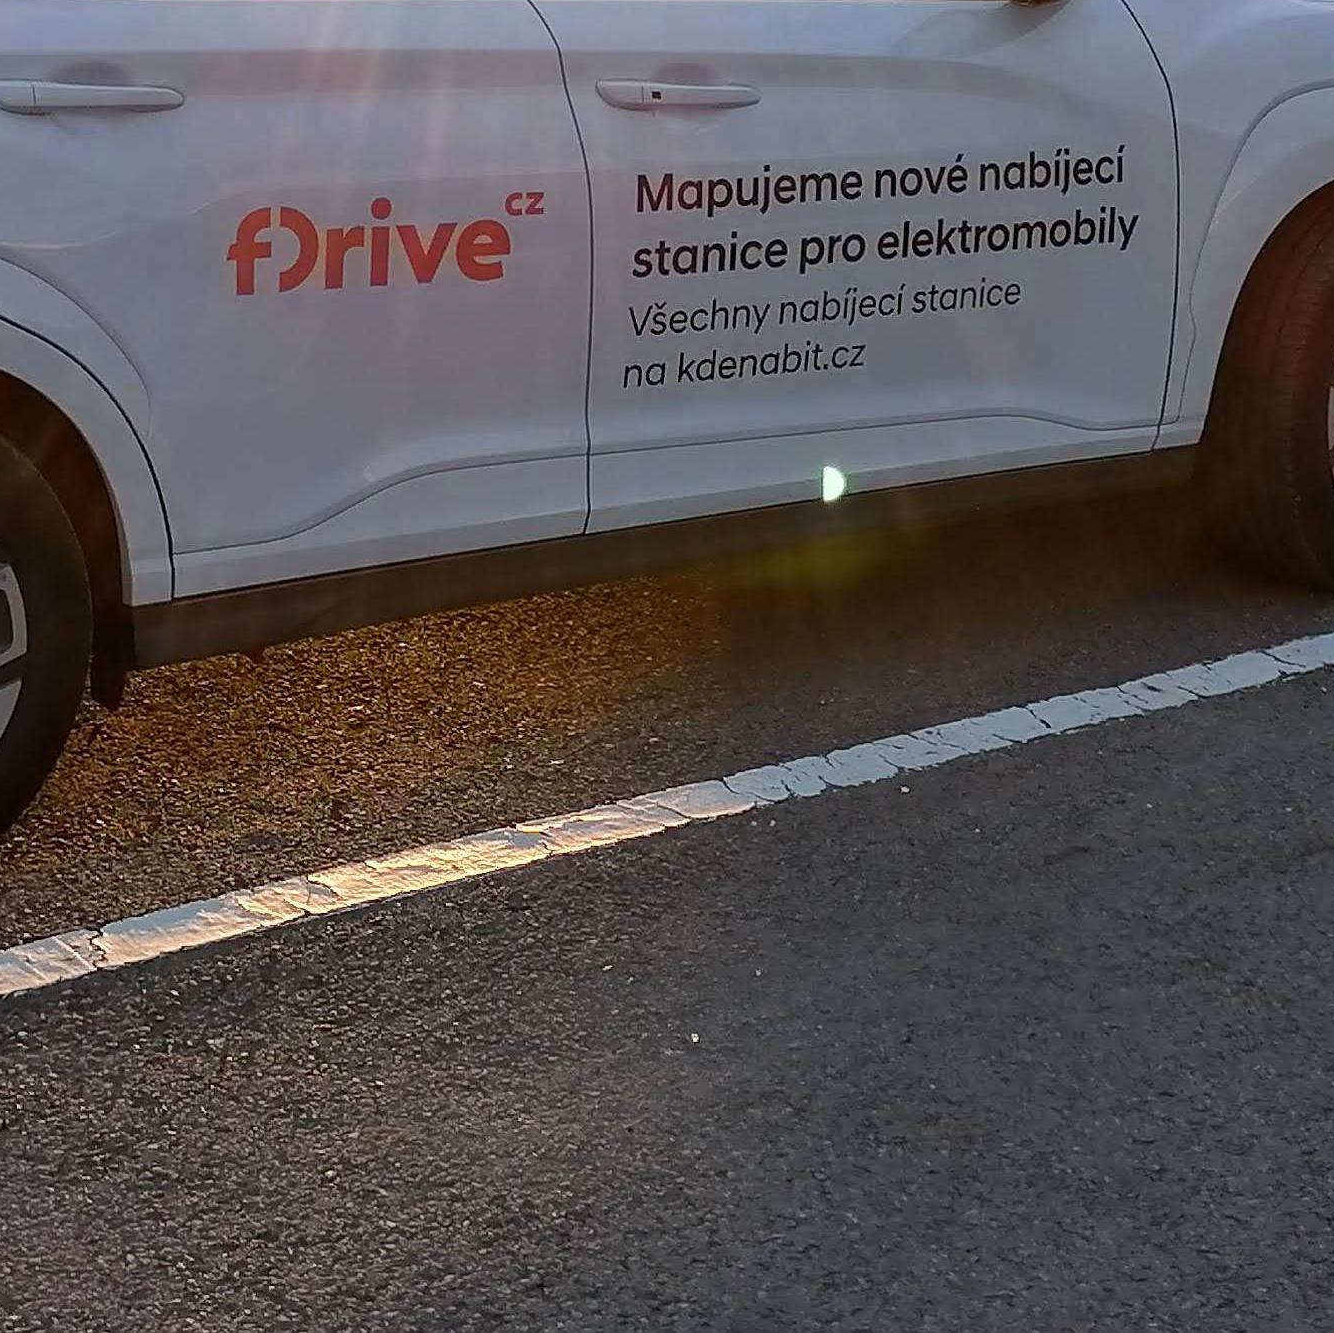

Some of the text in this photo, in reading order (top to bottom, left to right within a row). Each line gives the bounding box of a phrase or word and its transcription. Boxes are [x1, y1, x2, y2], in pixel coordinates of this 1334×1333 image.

[635, 145, 1125, 217] Mapujeme nové nabíjecí
[631, 206, 1140, 279] stanice pro elektromobily
[628, 276, 1022, 337] Všechny nabíjecí stanice
[623, 340, 867, 388] na kdenabit.cz
